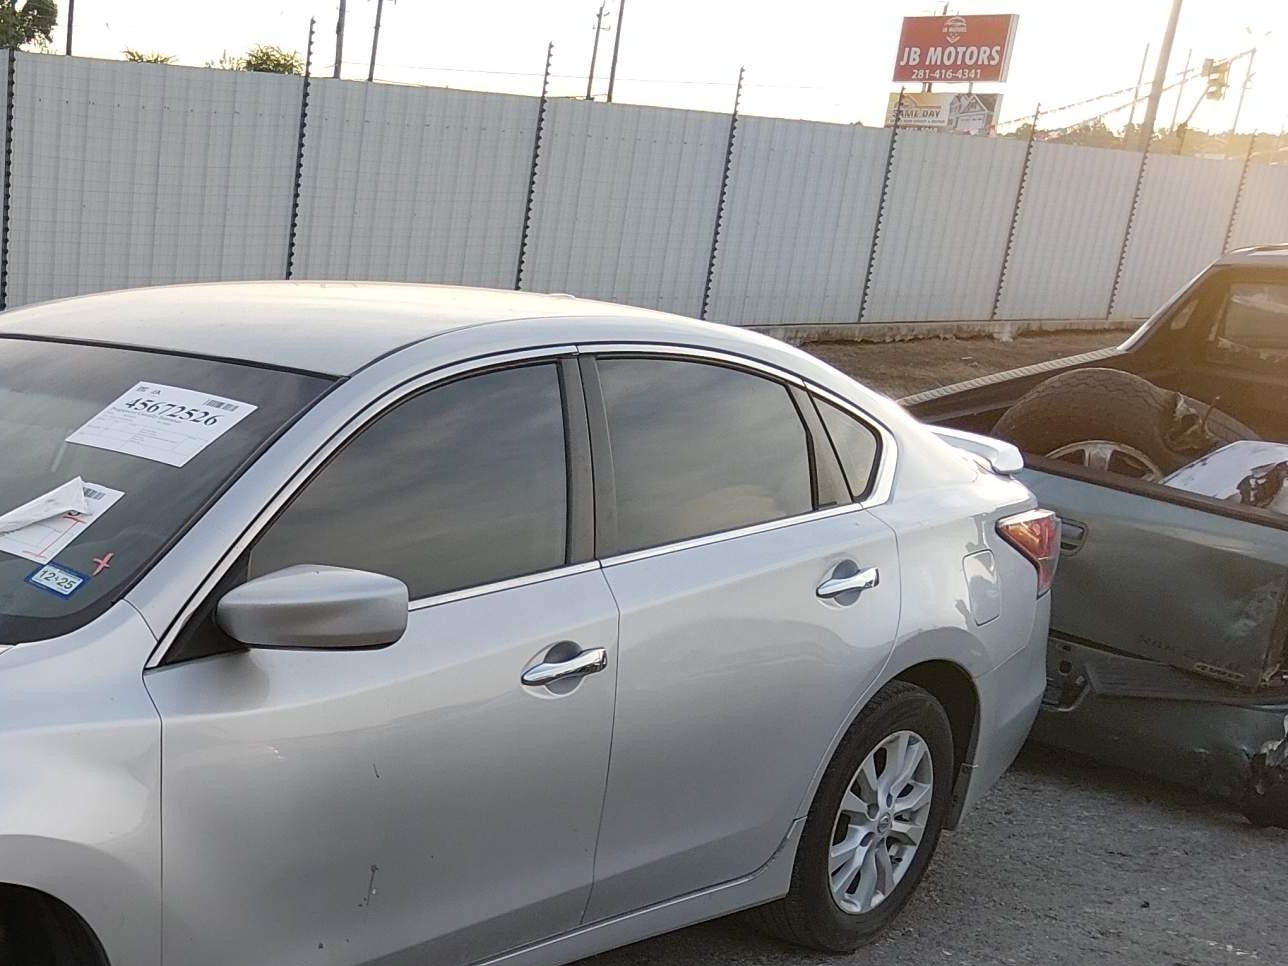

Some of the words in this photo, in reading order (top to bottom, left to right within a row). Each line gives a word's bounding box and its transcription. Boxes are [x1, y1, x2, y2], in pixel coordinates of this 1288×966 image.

[900, 47, 920, 66] JB
[926, 45, 1001, 66] MOTORS
[911, 69, 981, 79] 281-416-4341
[125, 397, 221, 426] 45672526
[39, 569, 56, 582] 12
[56, 577, 77, 590] 25
